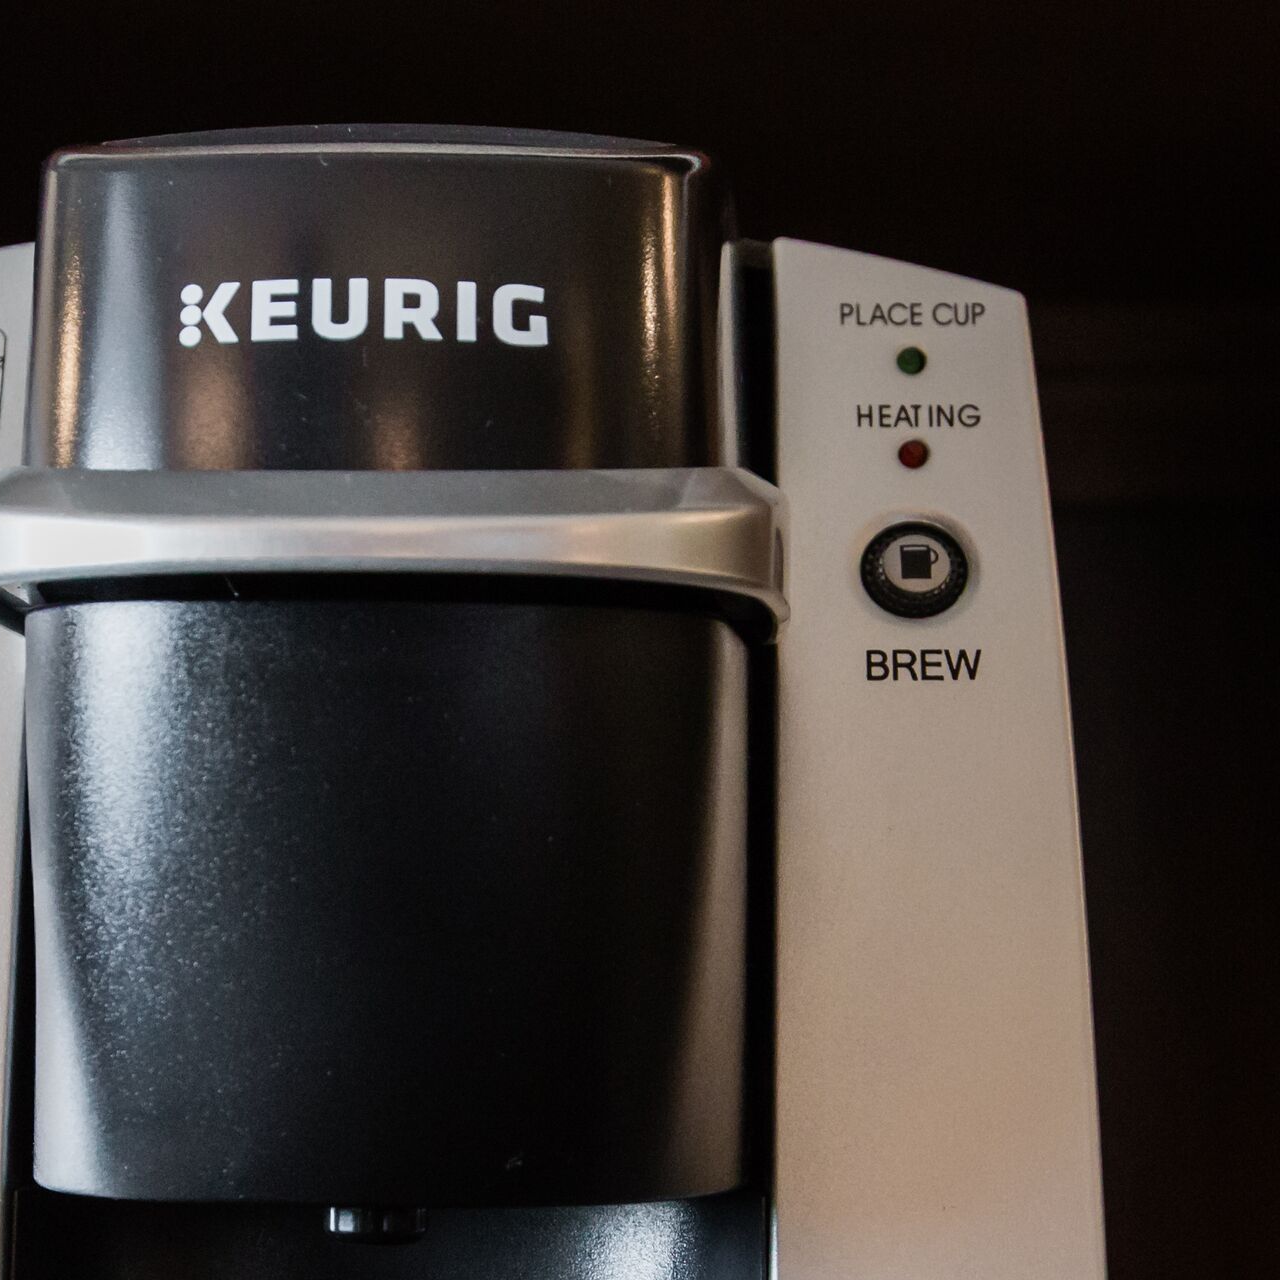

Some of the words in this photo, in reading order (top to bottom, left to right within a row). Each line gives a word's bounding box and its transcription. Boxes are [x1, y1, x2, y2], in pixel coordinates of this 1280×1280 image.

[178, 277, 550, 348] KEURIG
[839, 302, 923, 326] PLACE
[932, 302, 987, 326] CUP
[856, 404, 982, 429] HEATING
[865, 649, 982, 681] BREW
